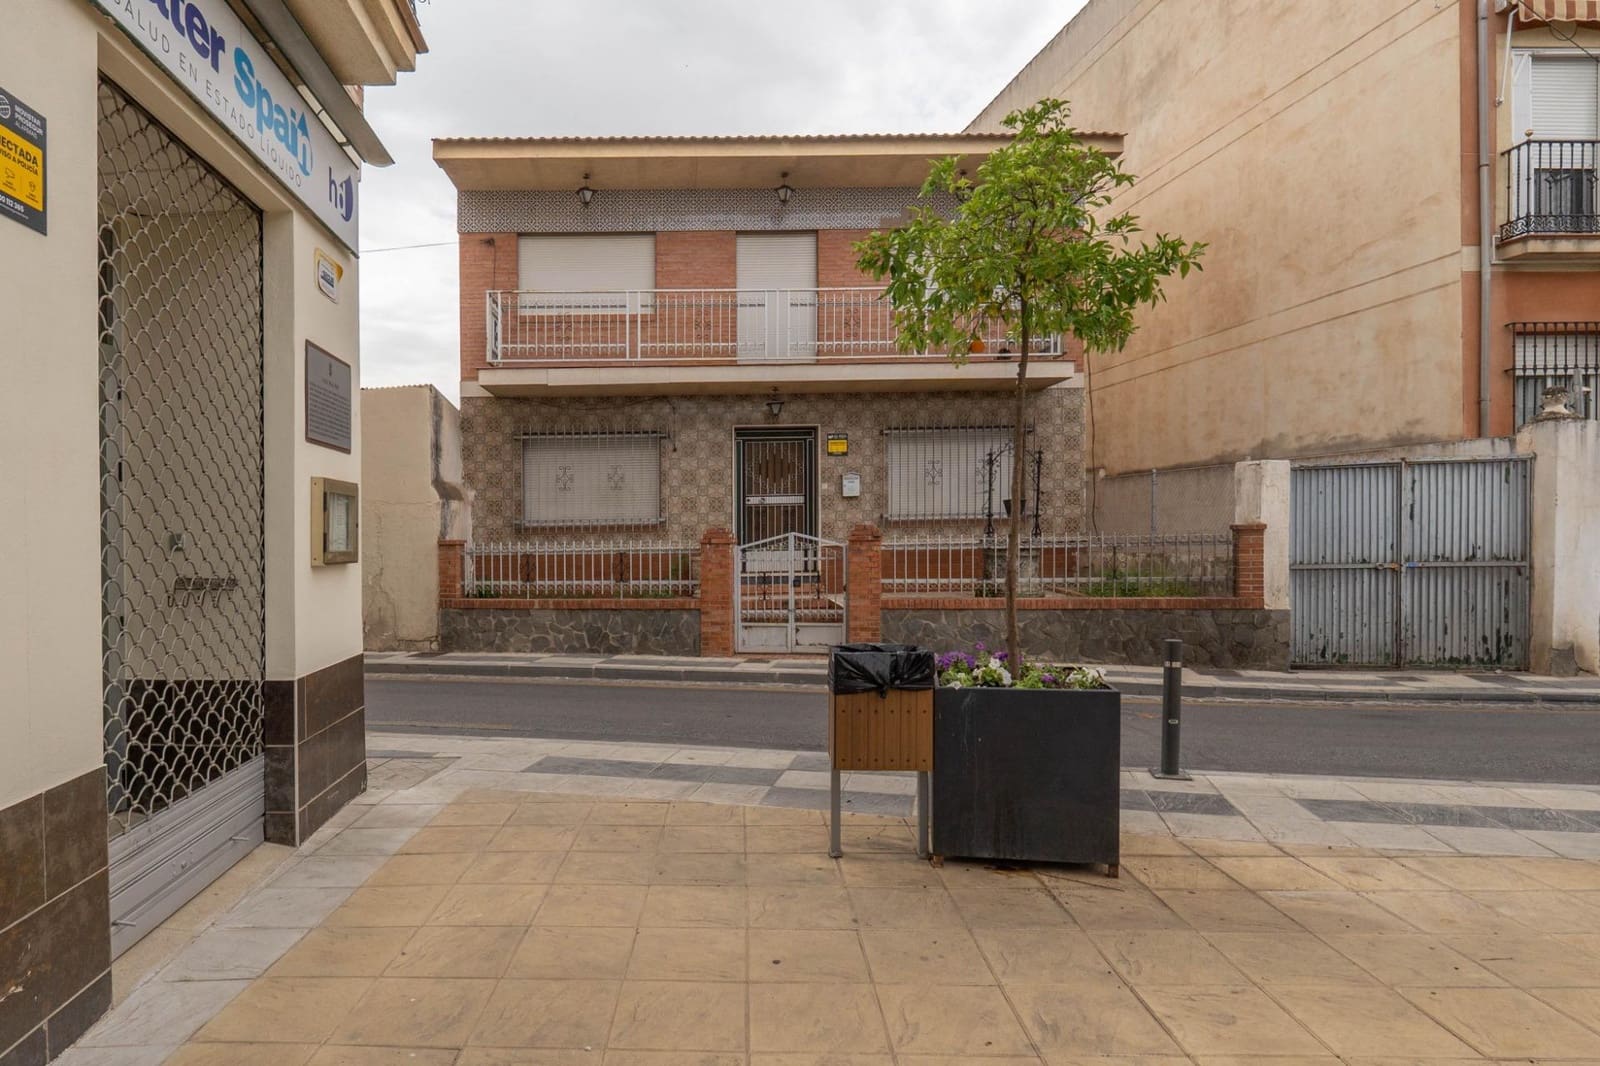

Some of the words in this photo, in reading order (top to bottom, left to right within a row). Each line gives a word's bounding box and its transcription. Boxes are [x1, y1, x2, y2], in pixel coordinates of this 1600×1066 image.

[179, 52, 198, 83] EN
[205, 79, 255, 139] ESTADO
[233, 47, 313, 176] Spain
[0, 135, 39, 167] ECTADA
